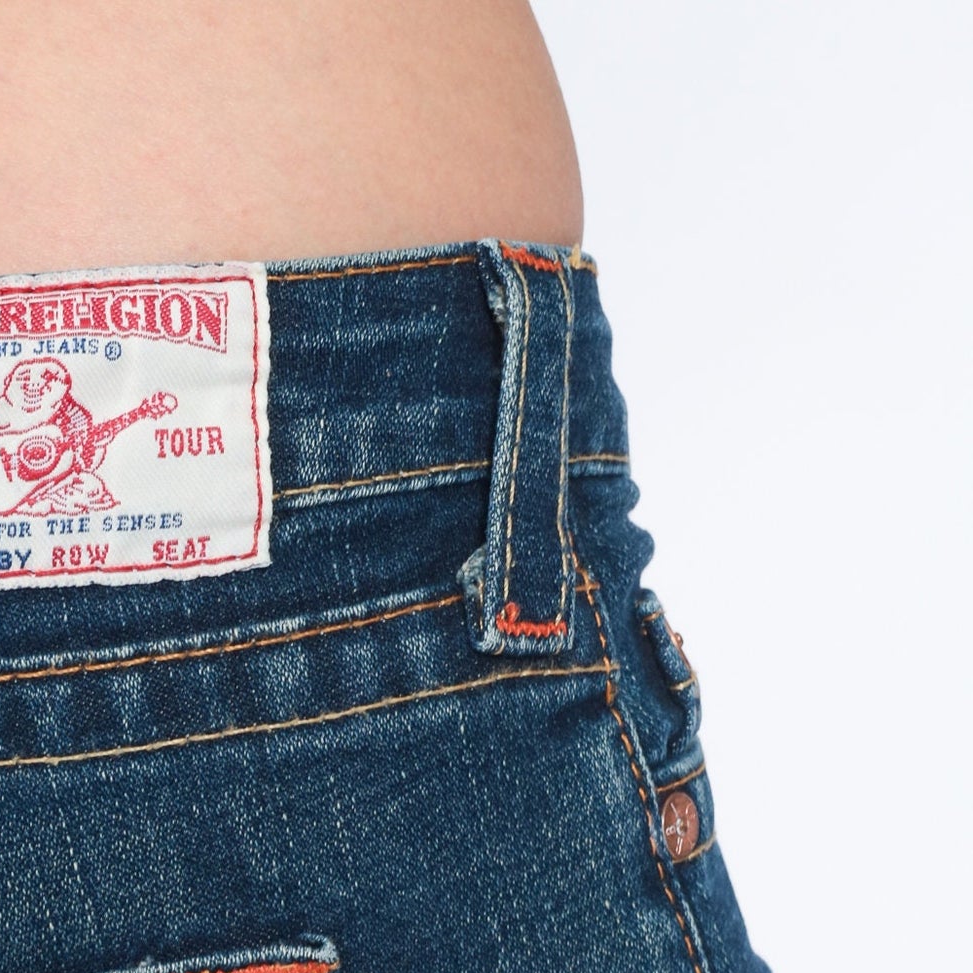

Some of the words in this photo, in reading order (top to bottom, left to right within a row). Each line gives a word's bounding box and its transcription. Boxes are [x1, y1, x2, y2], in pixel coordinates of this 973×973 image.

[154, 427, 225, 458] TOUR
[46, 517, 89, 535] THE
[102, 513, 184, 532] SENSES
[51, 544, 110, 567] ROW
[152, 536, 211, 562] SEAT
